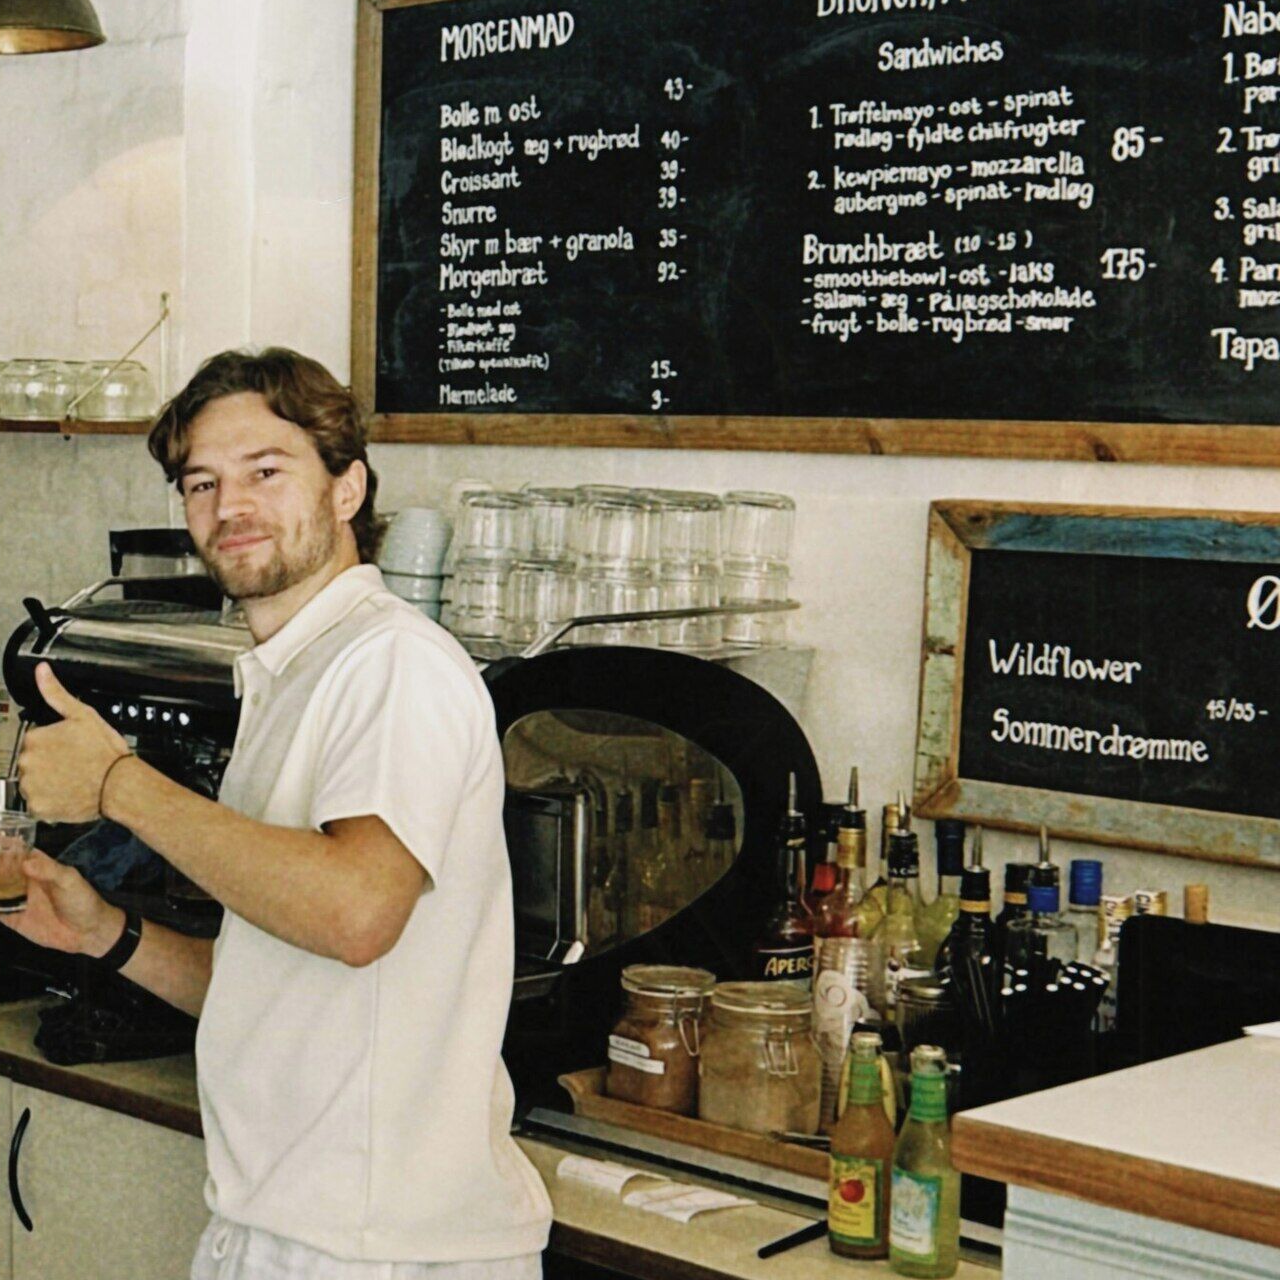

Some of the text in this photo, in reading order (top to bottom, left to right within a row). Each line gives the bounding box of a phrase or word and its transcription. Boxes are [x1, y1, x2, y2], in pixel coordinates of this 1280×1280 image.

[440, 11, 575, 62] MORGENMAD
[1222, 0, 1280, 38] Nab
[878, 36, 1004, 71] Sandwiches
[1222, 52, 1240, 84] 1.
[440, 101, 480, 129] Bolle
[508, 94, 541, 122] ost
[809, 105, 823, 130] 1.
[829, 100, 935, 127] Trøffelmayo
[948, 97, 983, 116] ost
[1003, 86, 1074, 117] spinat
[440, 131, 515, 166] Blødkogt
[523, 138, 549, 165] æg
[568, 123, 640, 161] rugbrød
[834, 128, 893, 152] rødløg
[907, 123, 964, 152] fyldte
[1216, 126, 1237, 153] 2.
[440, 166, 522, 195] Croissant
[807, 170, 826, 191] 2.
[833, 163, 952, 192] kewpiemayo
[970, 150, 1085, 178] mozzarella
[441, 201, 498, 225] Snurre
[834, 189, 928, 216] aubergine
[944, 180, 1011, 211] spinat
[1024, 177, 1095, 209] rødløg
[1214, 196, 1235, 220] 3.
[440, 232, 480, 263] Skyr
[504, 228, 543, 255] bær
[565, 226, 635, 261] granola
[802, 230, 944, 265] Brunchbræt
[439, 260, 549, 299] Morgenbræt
[476, 299, 501, 318] med
[439, 381, 518, 406] Marmelade
[988, 638, 1142, 685] Wildflower
[991, 708, 1210, 764] Sommerdrømme
